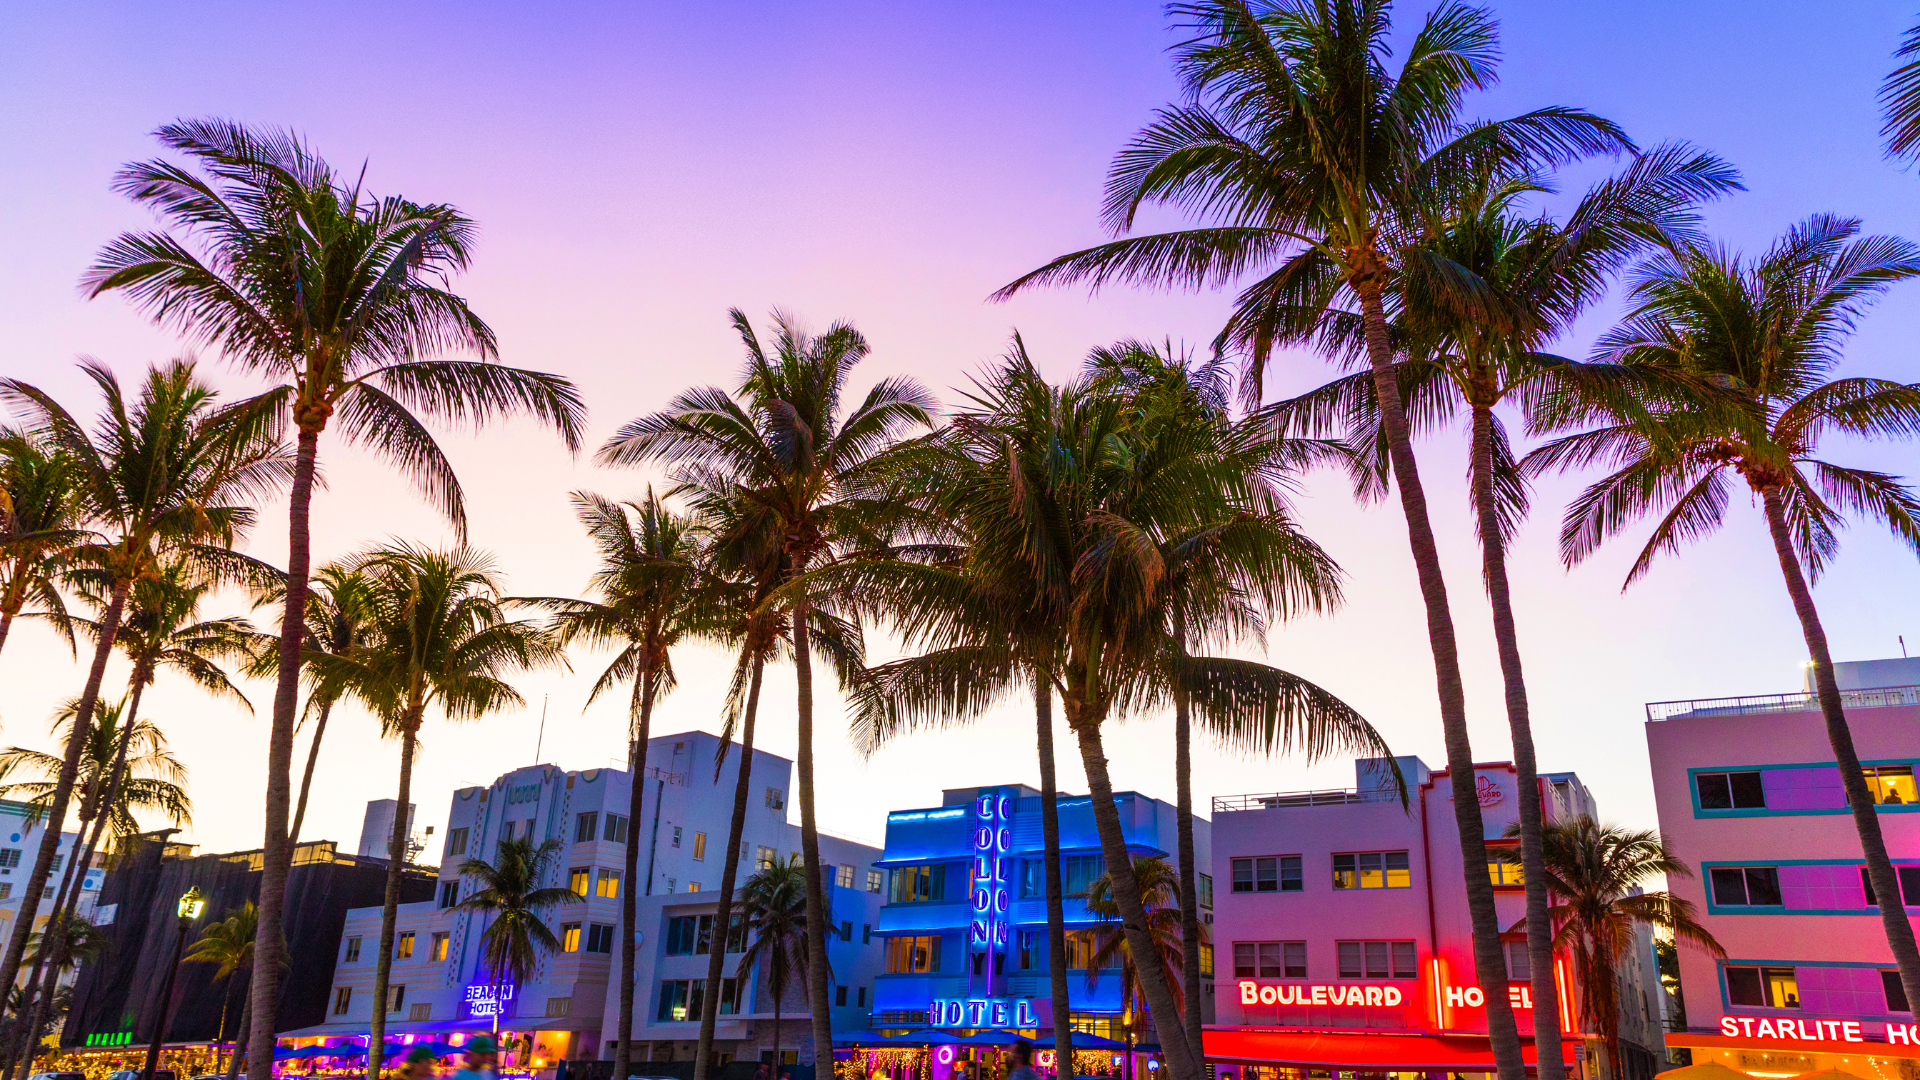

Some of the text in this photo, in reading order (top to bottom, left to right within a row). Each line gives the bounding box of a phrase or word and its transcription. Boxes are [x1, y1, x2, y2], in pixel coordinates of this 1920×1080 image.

[971, 797, 992, 975] COLONY
[996, 798, 1011, 975] COLONY
[465, 985, 513, 1000] BEACN
[1239, 981, 1533, 1008] BOULEVARD HOEL
[929, 1001, 1037, 1026] HOTEL
[1721, 1016, 1864, 1042] STARLITE
